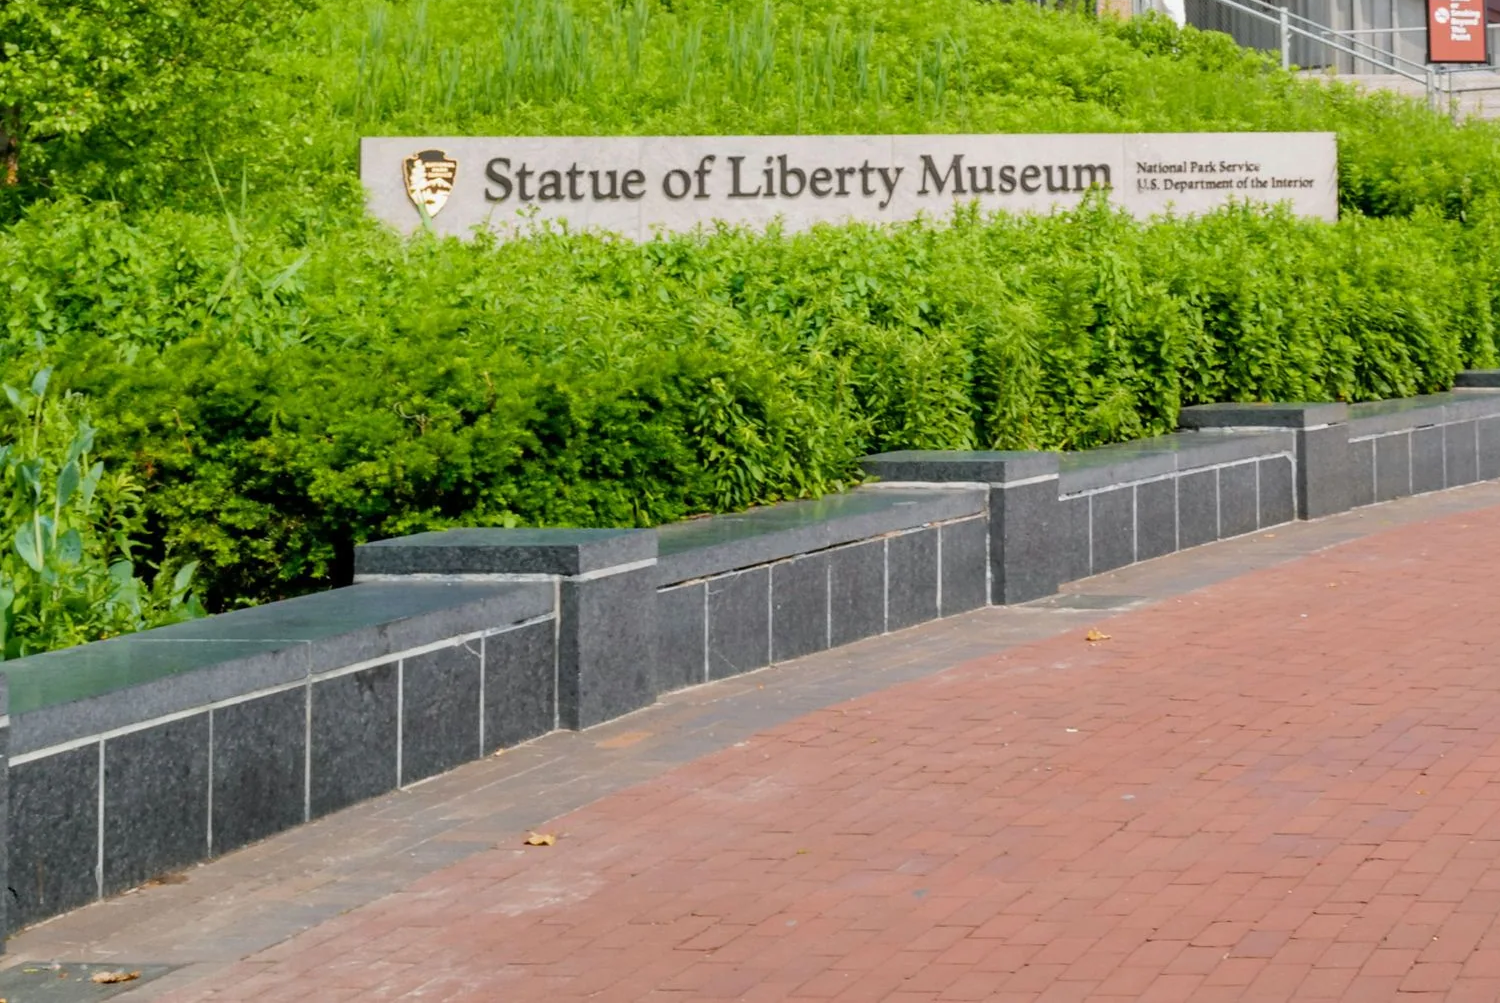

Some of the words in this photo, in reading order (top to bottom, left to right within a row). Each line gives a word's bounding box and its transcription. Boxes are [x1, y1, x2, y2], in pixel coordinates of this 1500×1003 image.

[1136, 161, 1187, 174] National
[1190, 161, 1216, 174] Park
[1219, 160, 1261, 173] Service
[484, 156, 647, 202] Statue
[662, 153, 717, 200] of
[727, 153, 904, 210] Liberty
[917, 153, 1114, 194] Museum
[1137, 179, 1160, 191] U.S.
[1164, 178, 1233, 193] Department
[1236, 177, 1248, 189] of
[1251, 177, 1268, 189] the
[1271, 176, 1315, 189] Interior
